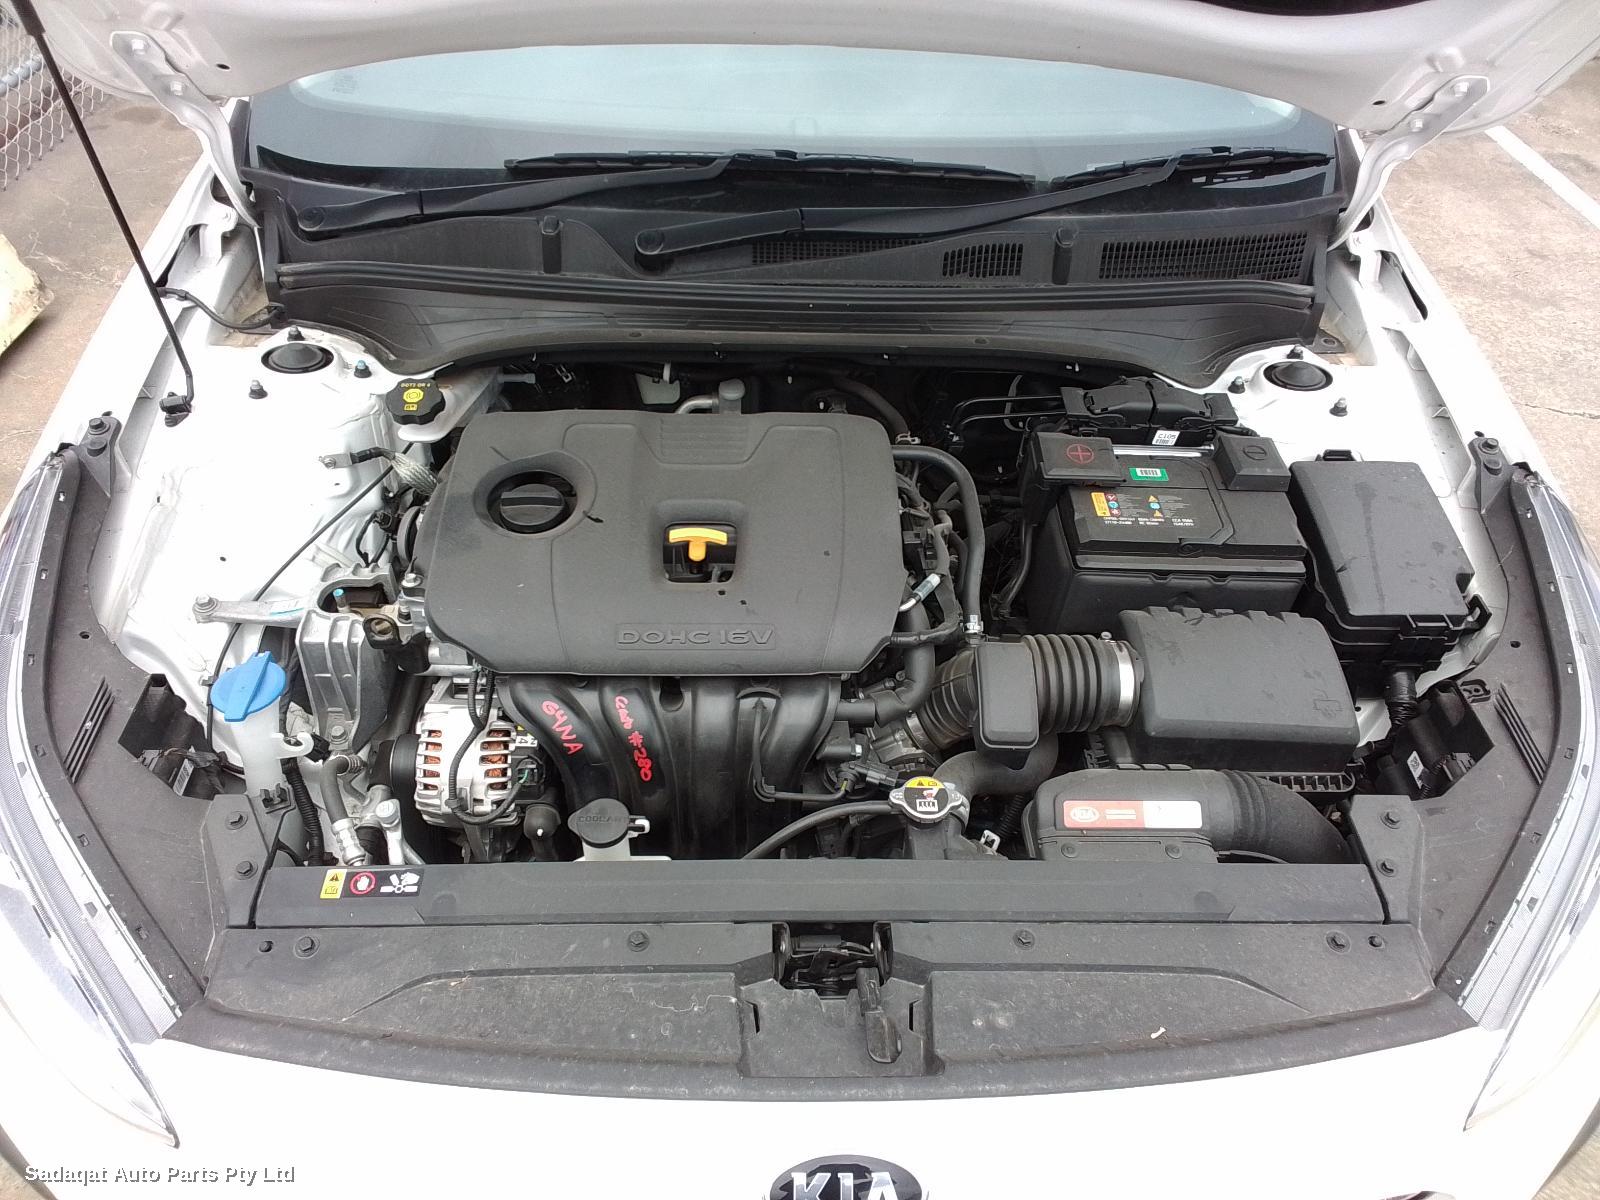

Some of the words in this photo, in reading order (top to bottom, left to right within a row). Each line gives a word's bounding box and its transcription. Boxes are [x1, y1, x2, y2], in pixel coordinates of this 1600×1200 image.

[617, 629, 711, 645] DOHC
[719, 629, 773, 645] 16V
[541, 700, 584, 755] G4NA
[790, 1171, 901, 1200] KIA
